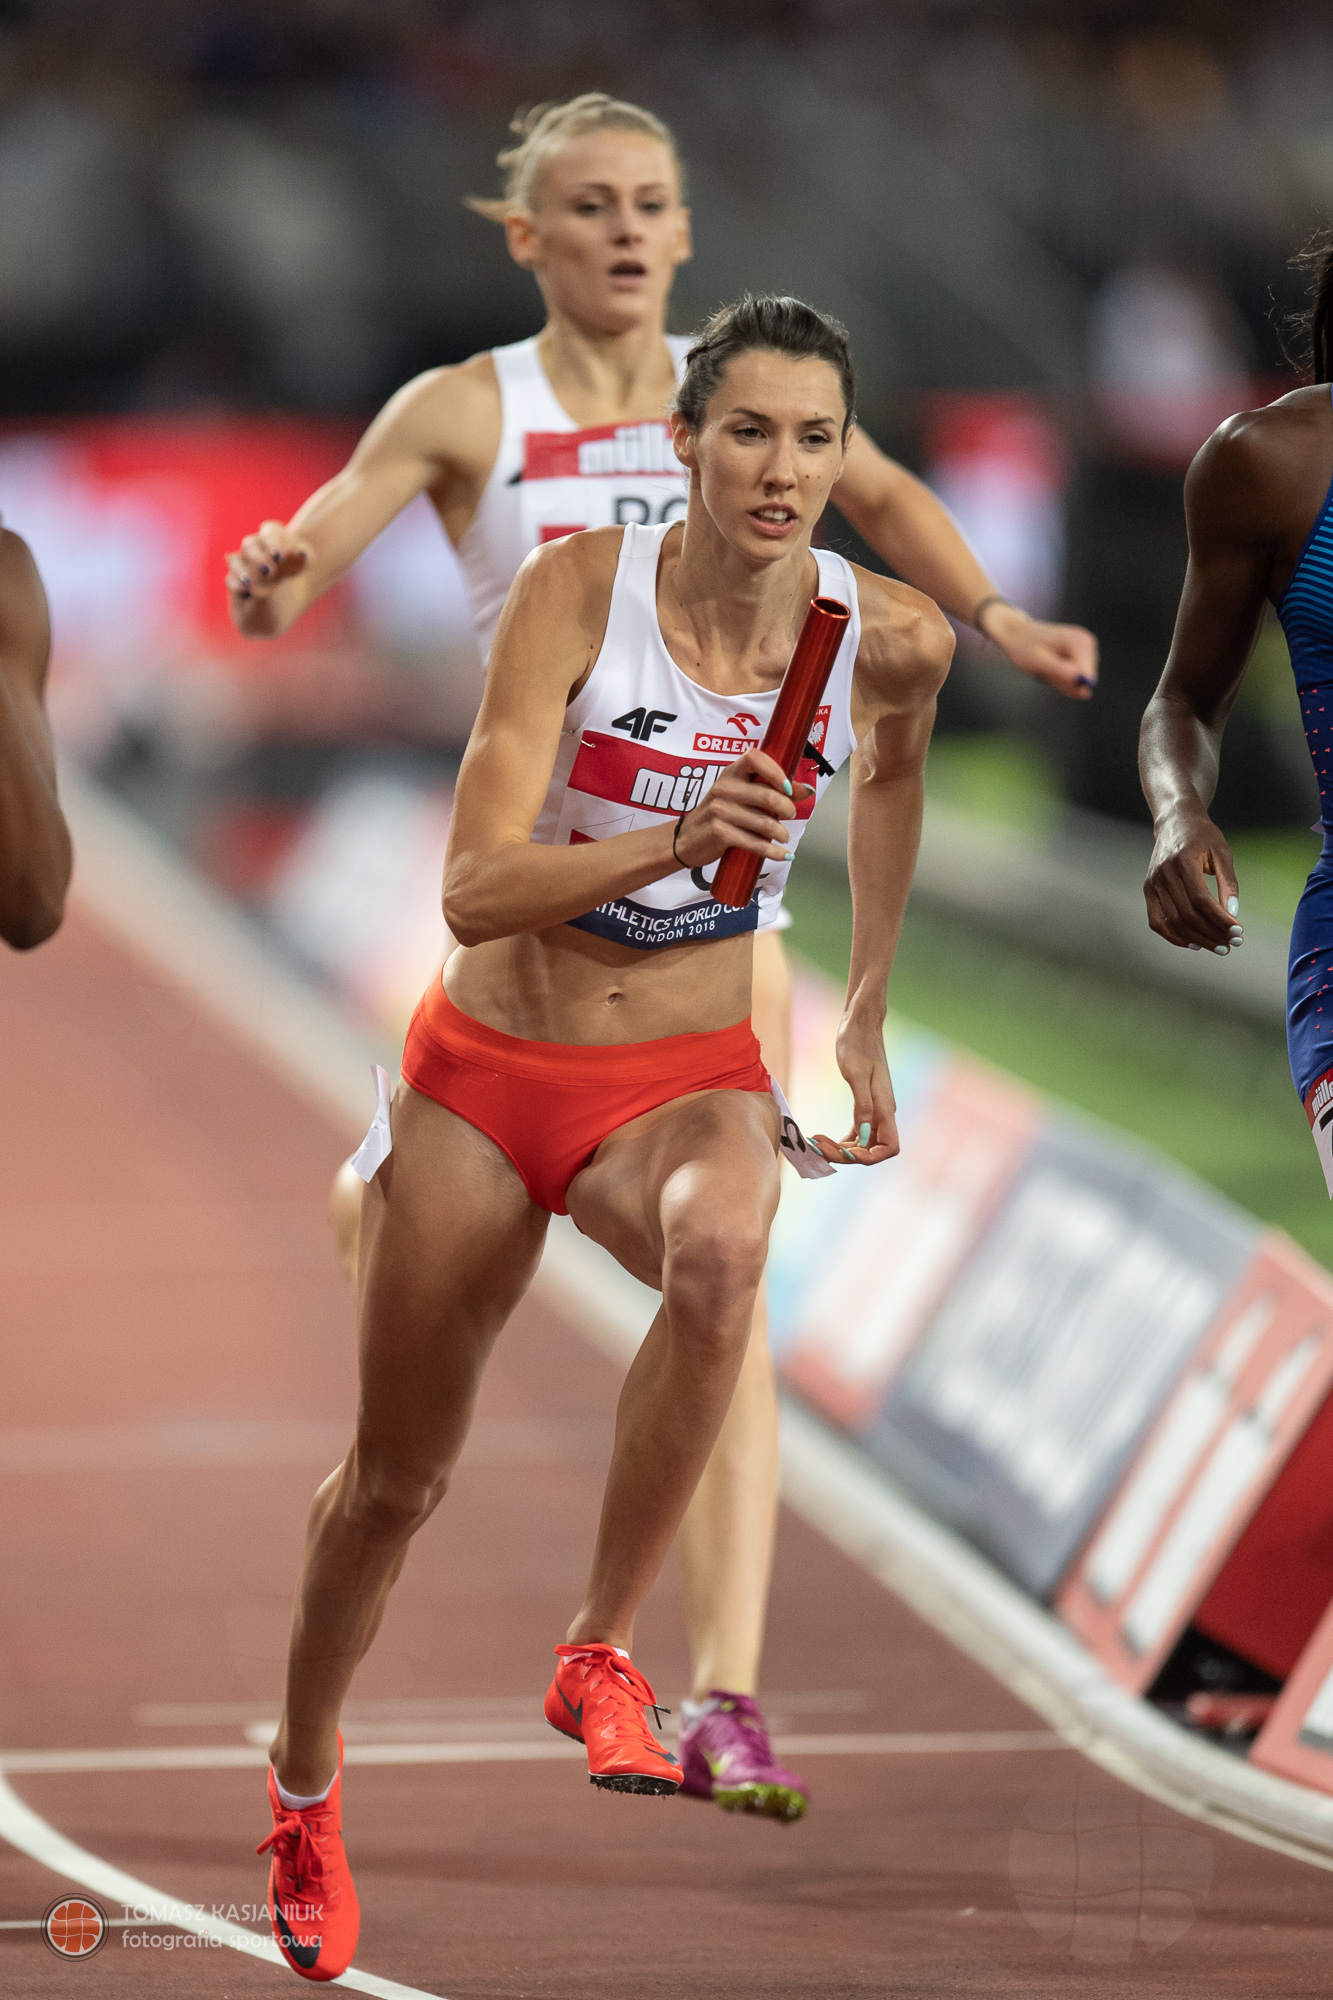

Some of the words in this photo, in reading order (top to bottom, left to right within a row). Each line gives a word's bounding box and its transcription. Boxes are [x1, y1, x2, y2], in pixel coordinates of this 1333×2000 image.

[611, 706, 678, 741] 4F
[696, 736, 755, 753] ORLEN
[596, 901, 672, 933] THLETICS
[673, 903, 722, 928] WORLD
[625, 926, 684, 943] LONDON
[688, 920, 715, 936] 2018
